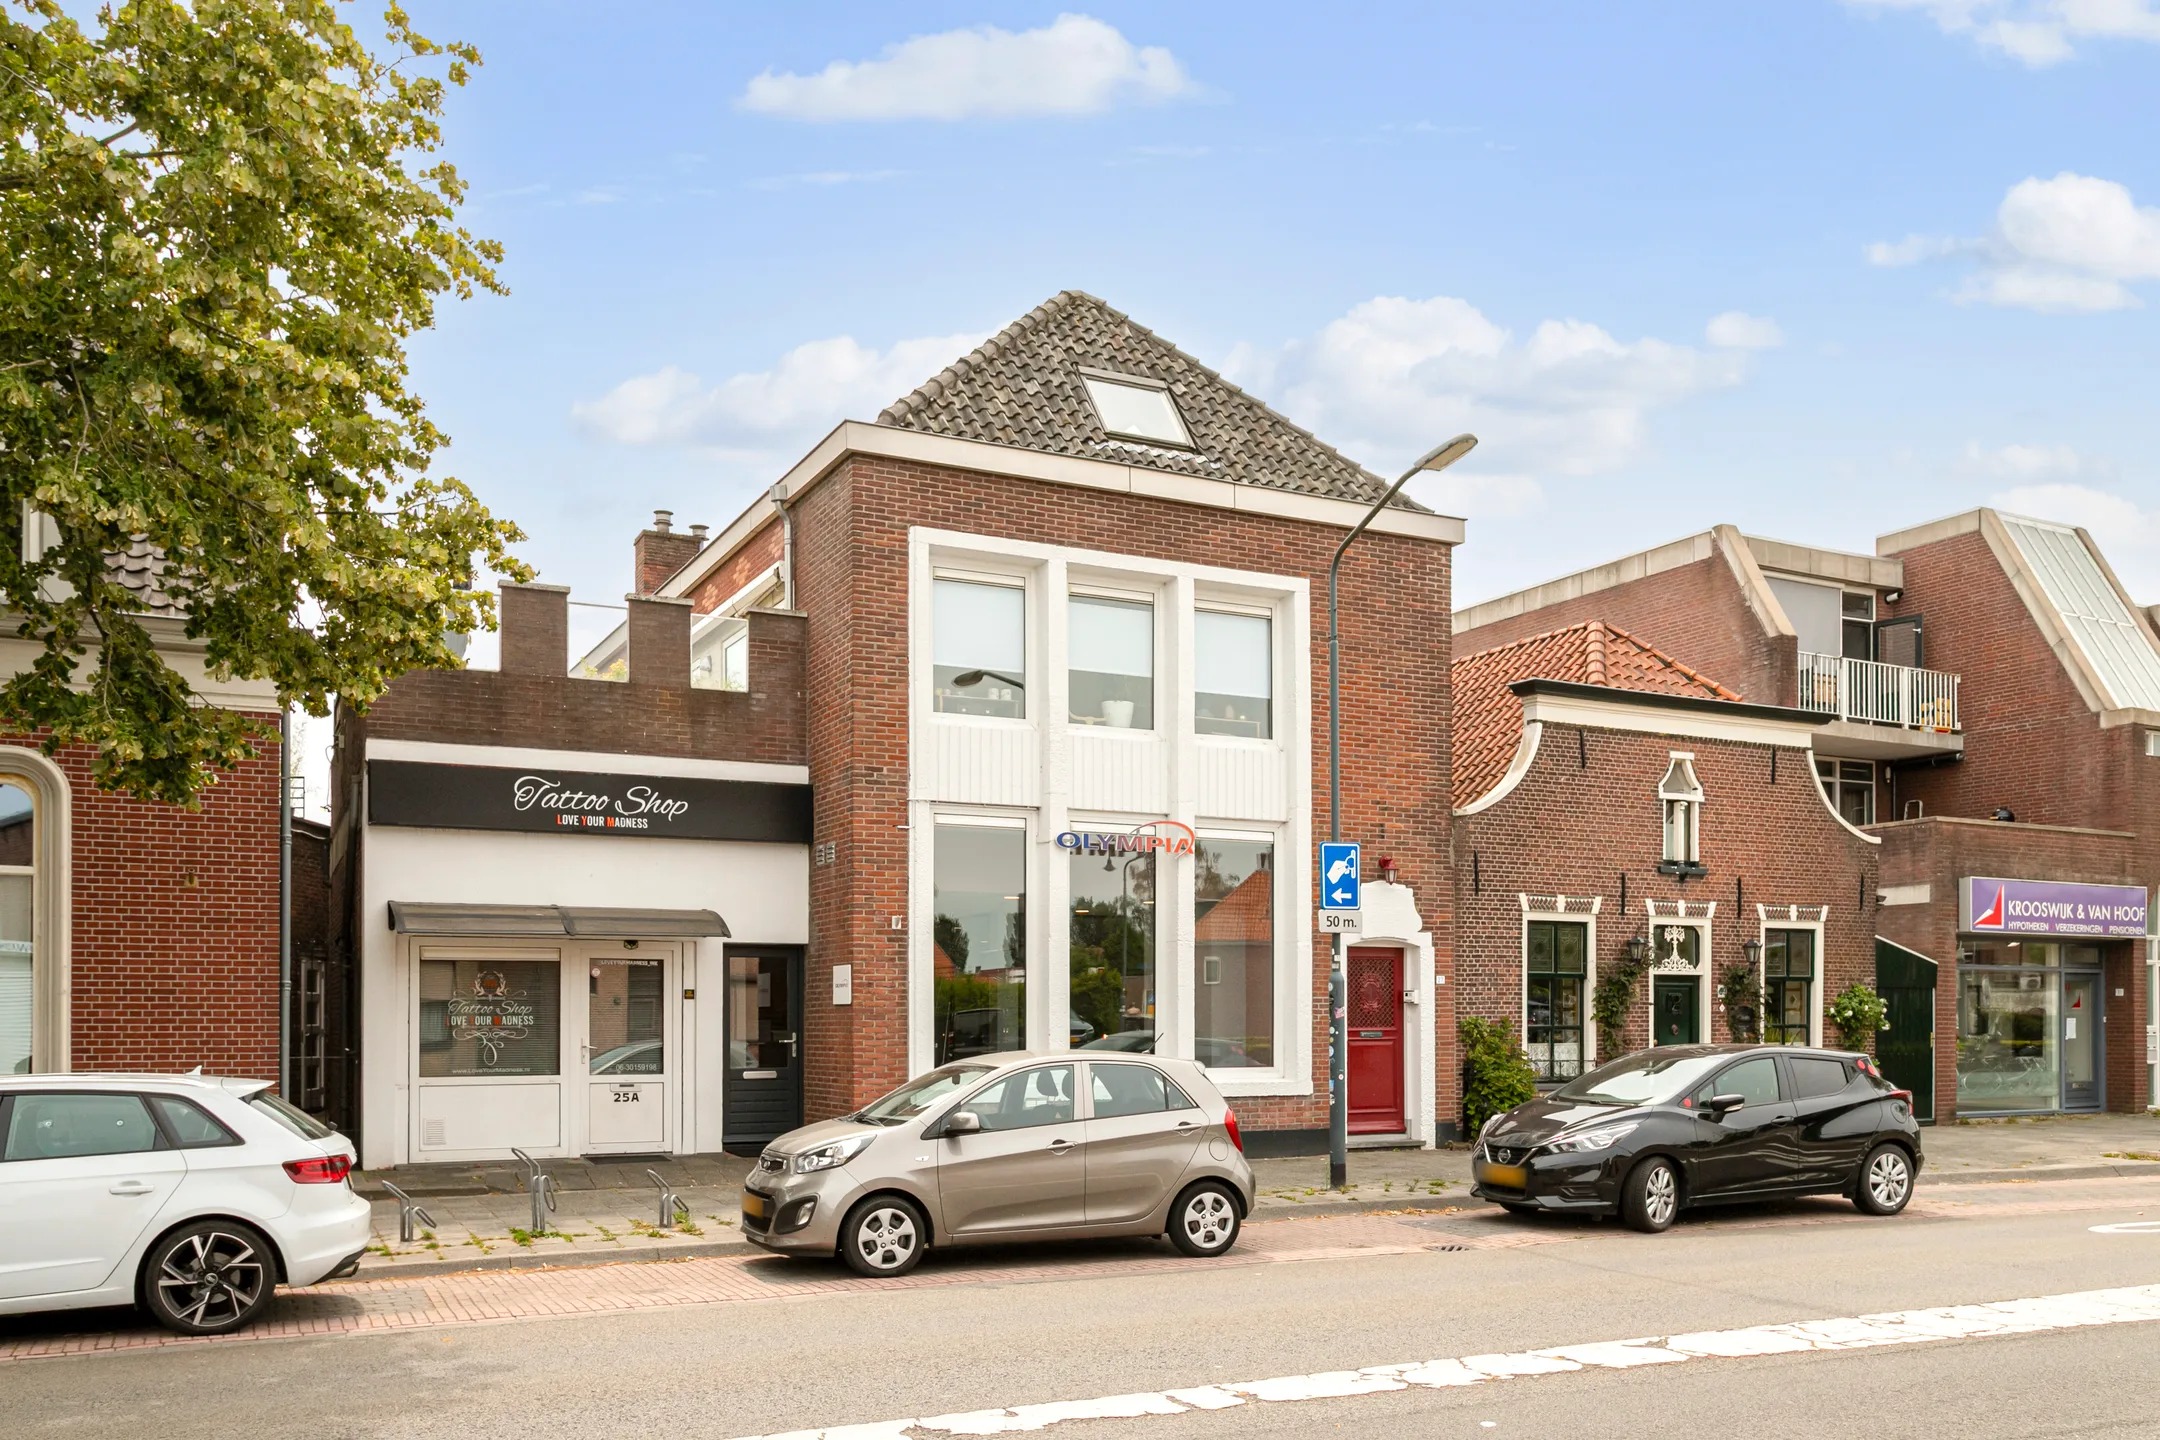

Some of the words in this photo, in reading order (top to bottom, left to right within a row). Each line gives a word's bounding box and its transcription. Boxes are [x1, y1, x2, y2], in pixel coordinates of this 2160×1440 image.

[514, 776, 609, 811] Tattoo
[614, 786, 688, 821] Shop
[557, 814, 579, 826] LOVE
[581, 815, 605, 827] YOUR
[606, 816, 648, 828] MADNESS
[1056, 831, 1195, 857] OLYMPIA
[2008, 900, 2074, 920] KROOSWIJK
[2076, 905, 2085, 919] &
[2088, 905, 2111, 921] VAN
[2114, 906, 2145, 922] HOOF
[1326, 915, 1340, 928] 50
[1343, 918, 1357, 928] m.
[2008, 921, 2049, 931] HYPOTHEKEN
[2055, 923, 2103, 934] VERZEKERINGEN
[2109, 925, 2145, 935] PENSIOENEN
[447, 998, 493, 1015] Tattoo
[496, 1001, 532, 1018] Shop
[616, 1063, 657, 1072] 06-30159198
[613, 1092, 639, 1103] 25A
